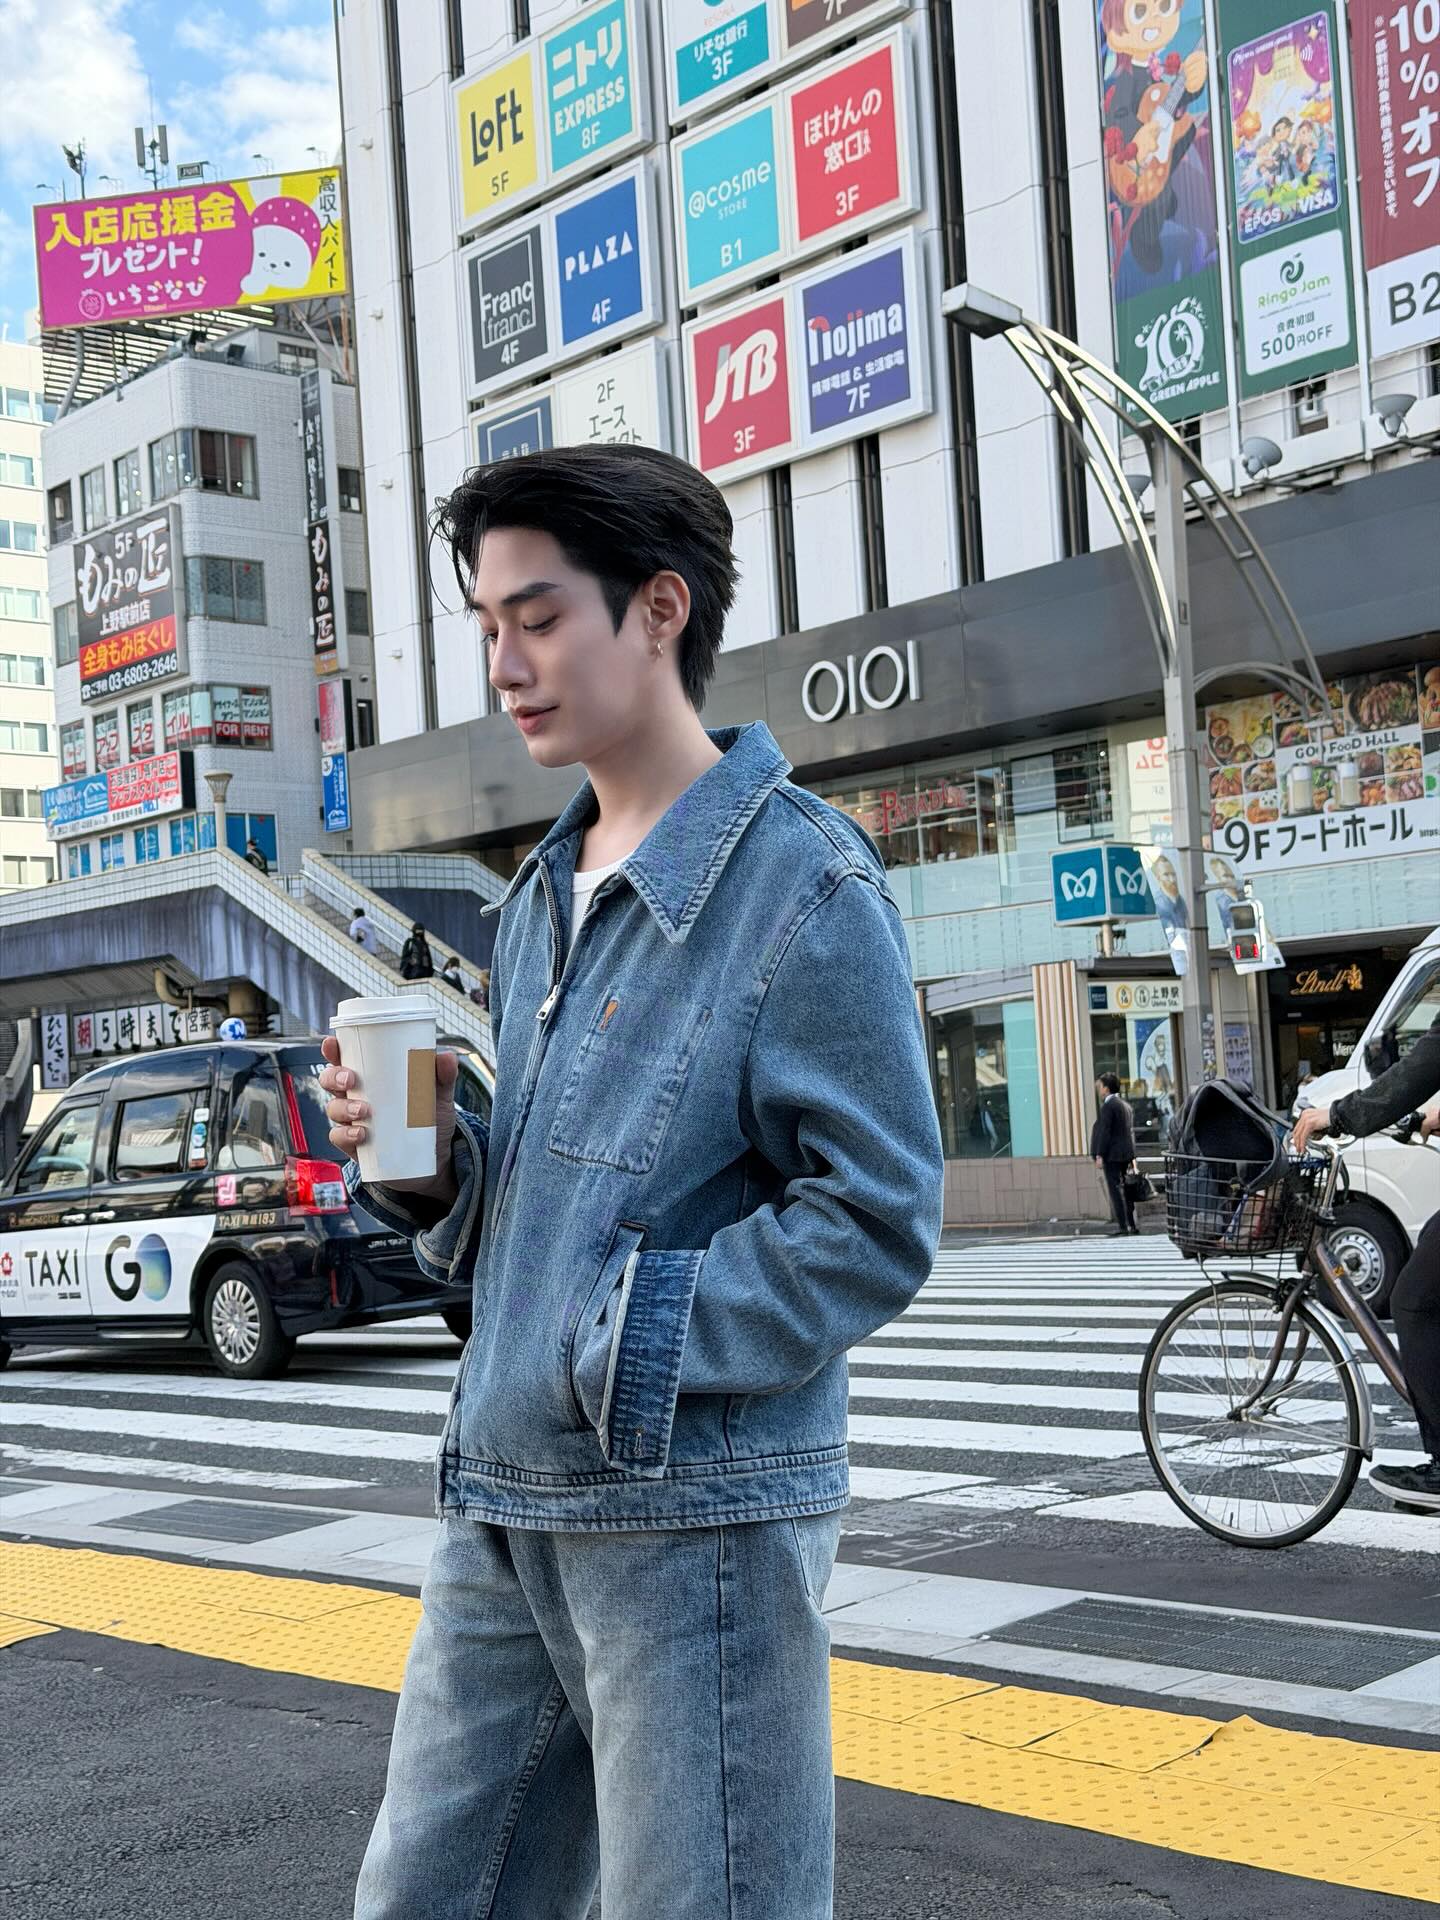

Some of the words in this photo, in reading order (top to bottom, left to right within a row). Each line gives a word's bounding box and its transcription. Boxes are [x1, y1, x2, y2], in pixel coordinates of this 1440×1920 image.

[694, 19, 747, 62] りそな銀行
[552, 18, 622, 101] ニトリ
[711, 50, 733, 81] 3F
[554, 76, 625, 136] EXPRESS
[803, 87, 882, 148] ほけんの
[581, 122, 601, 149] 8F
[823, 131, 863, 175] 窓口
[491, 170, 510, 196] 5F
[688, 161, 772, 219] @cosme
[834, 184, 860, 217] 3F
[44, 191, 237, 252] 入店応援金
[717, 199, 747, 221] STORE
[1244, 207, 1282, 234] EPOS
[1299, 188, 1335, 214] VISA
[318, 174, 339, 289] 高収入バイト
[564, 231, 634, 281] PLAZA
[720, 238, 743, 268] B1
[105, 275, 208, 307] いちごなび
[482, 279, 533, 322] Franc
[1257, 287, 1298, 310] Ringo
[1301, 274, 1331, 294] Jam
[486, 307, 531, 344] franc
[592, 298, 611, 324] 4F
[500, 339, 520, 365] 4F
[807, 303, 904, 368] nojima
[597, 378, 615, 404] 2F
[704, 328, 779, 425] JTB
[1149, 383, 1186, 404] GREEN
[1186, 371, 1220, 393] APPLE
[846, 382, 871, 413] 7F
[588, 405, 626, 438] エース
[733, 426, 756, 453] 3F
[114, 532, 133, 560] 5F
[77, 517, 171, 616] もみの匠
[311, 526, 334, 646] もみの匠
[83, 621, 174, 677] 全身もみほぐし
[108, 652, 178, 692] 03-6803-2646
[216, 722, 240, 736] FOR
[243, 724, 270, 737] RENT
[1151, 986, 1179, 999] 上野駅
[219, 1214, 240, 1229] TAXI
[24, 1248, 80, 1288] TAXI
[105, 1232, 172, 1302] GO
